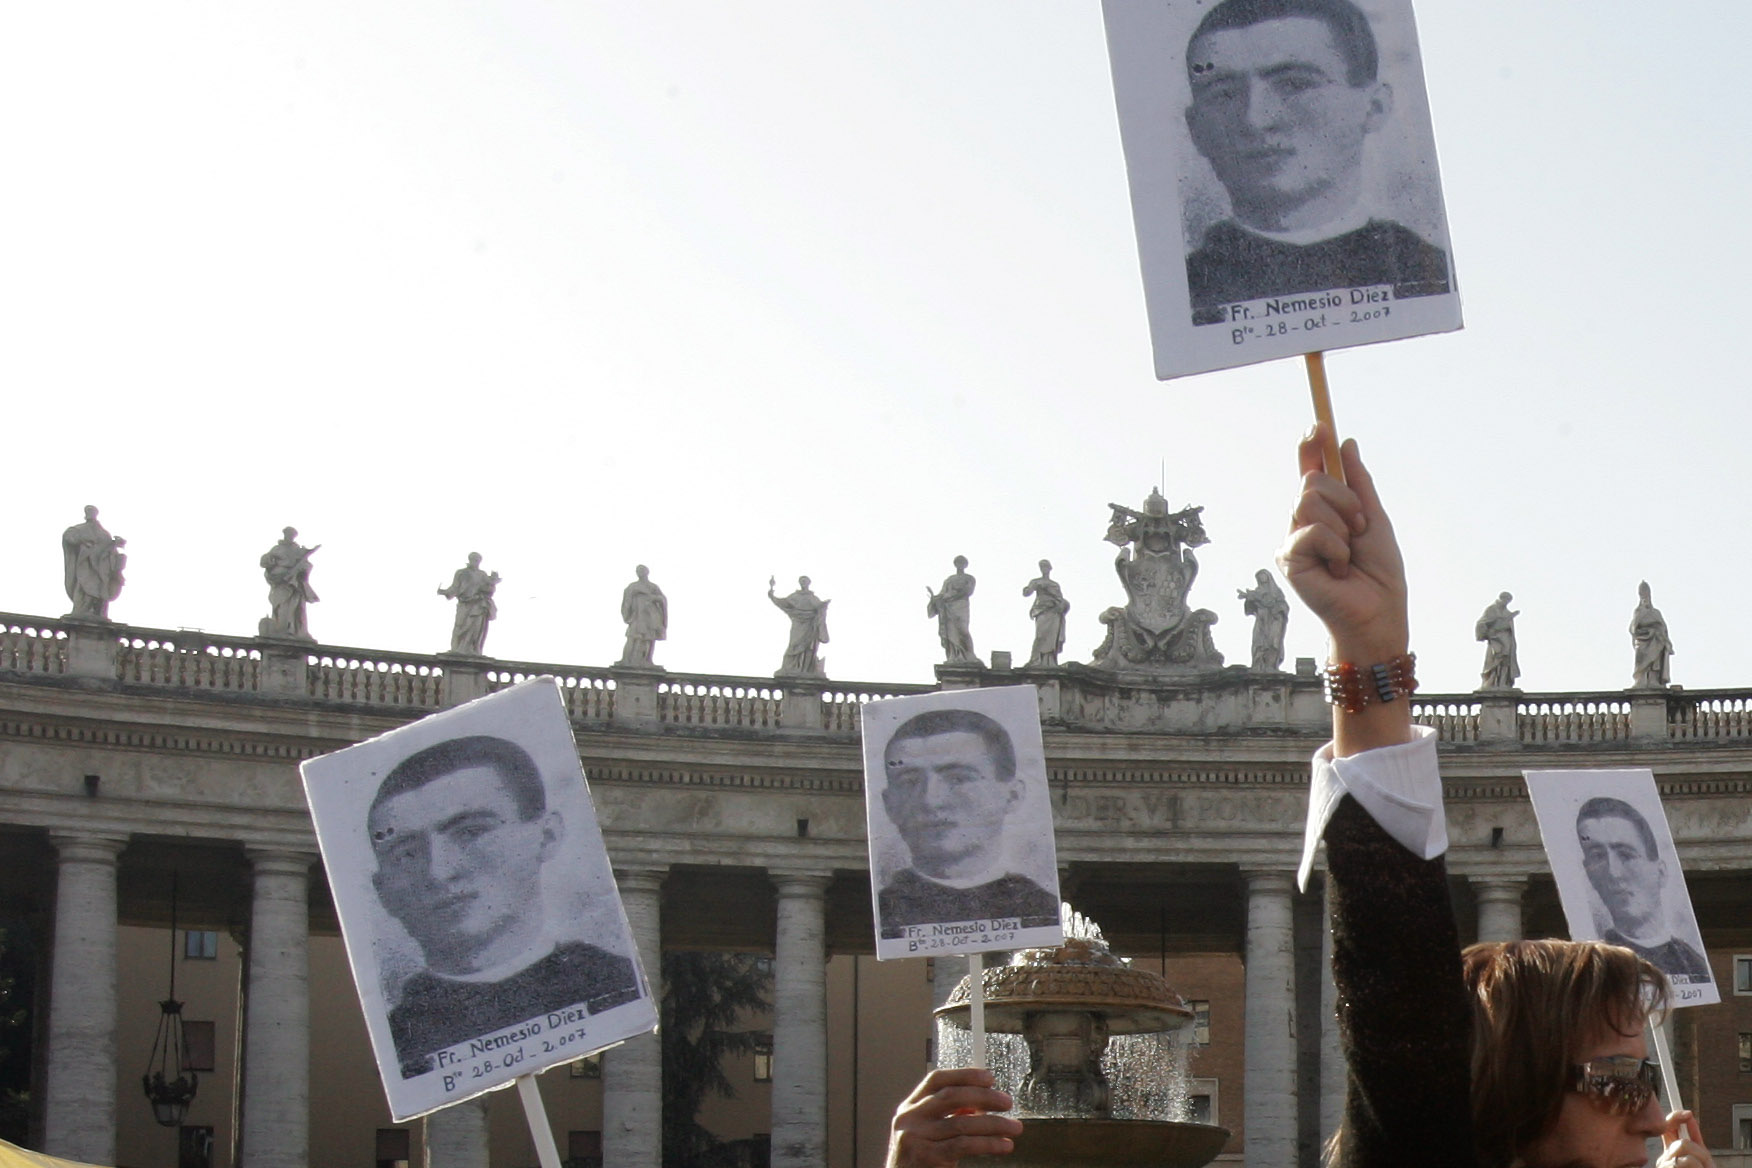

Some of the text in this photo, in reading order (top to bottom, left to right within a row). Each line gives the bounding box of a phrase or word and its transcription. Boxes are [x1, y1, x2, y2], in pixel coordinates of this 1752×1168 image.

[1230, 288, 1390, 322] Fr. Nemesio Diez
[907, 919, 1019, 938] Fr. Nemesio Diez
[436, 1009, 586, 1069] Fr. Nemesio Diez
